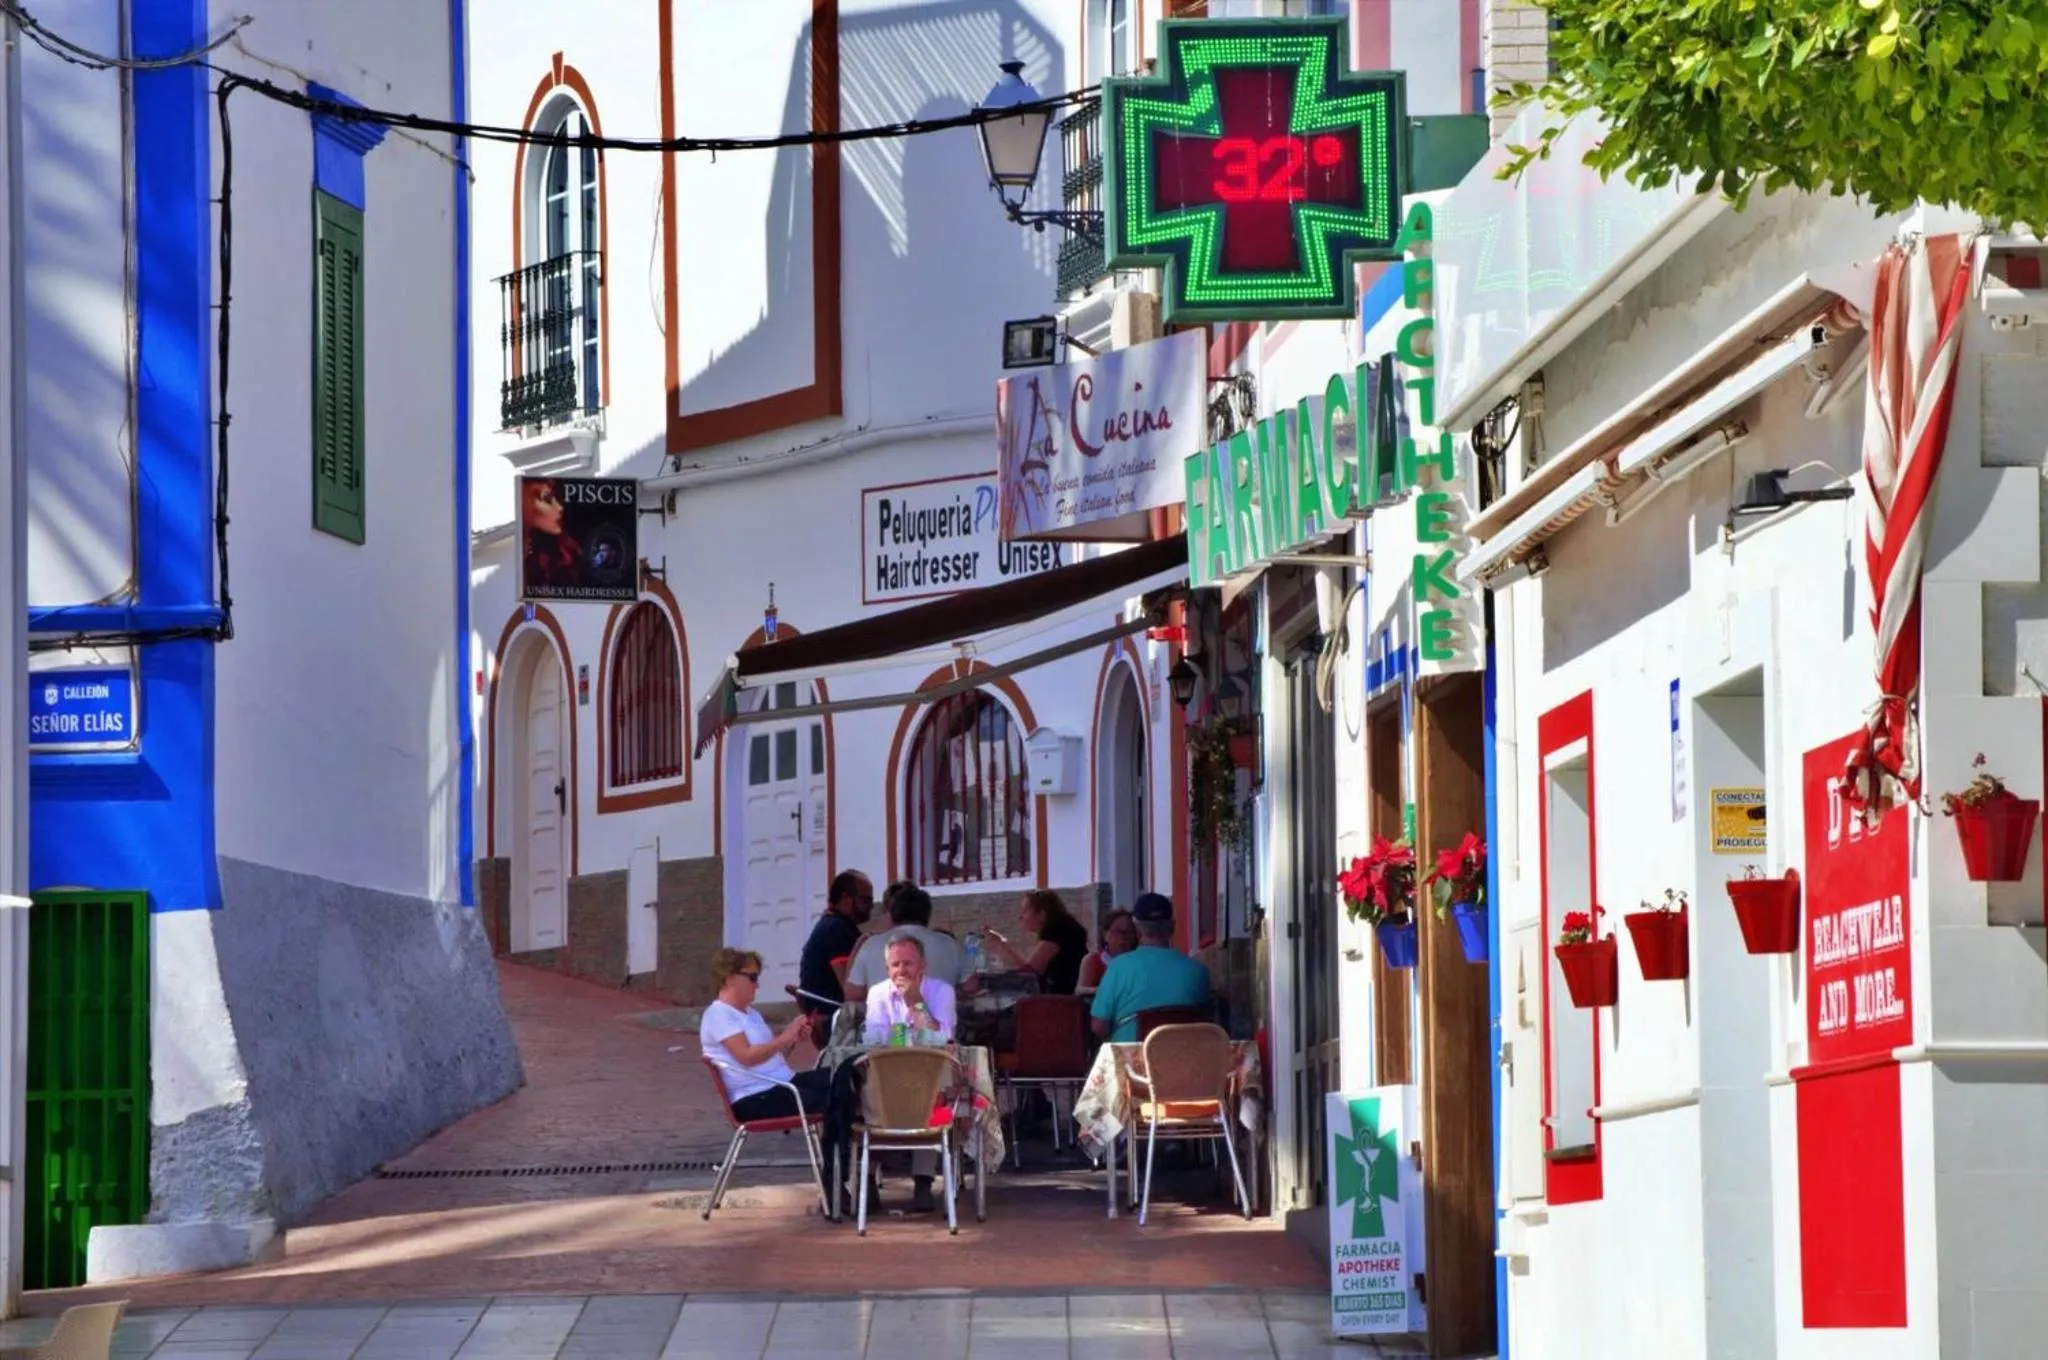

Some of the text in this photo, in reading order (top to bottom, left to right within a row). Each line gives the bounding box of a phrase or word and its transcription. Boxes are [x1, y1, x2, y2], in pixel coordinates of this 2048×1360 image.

[1212, 136, 1342, 202] 32°
[1070, 373, 1174, 458] Cucina
[1396, 201, 1461, 662] APOTHEKE
[1184, 352, 1411, 588] FARMACIA
[563, 484, 634, 504] PISCIS
[1056, 499, 1079, 521] Fine
[1115, 483, 1137, 513] food
[879, 495, 972, 549] Peluqueria
[877, 541, 1062, 592] Hairdresser Unisex
[526, 585, 634, 598] UNISEX HAIRDRESSER
[31, 709, 123, 734] SEÑOR ELÍAS
[1813, 896, 1904, 970] BEACHWEAR
[1818, 978, 1848, 1036] AND
[1336, 1241, 1401, 1258] FARMACIA
[1338, 1258, 1400, 1274] APOTHEKE
[1342, 1275, 1396, 1290] CHEMIST
[1341, 1312, 1400, 1326] OPEN EVERY DAY
